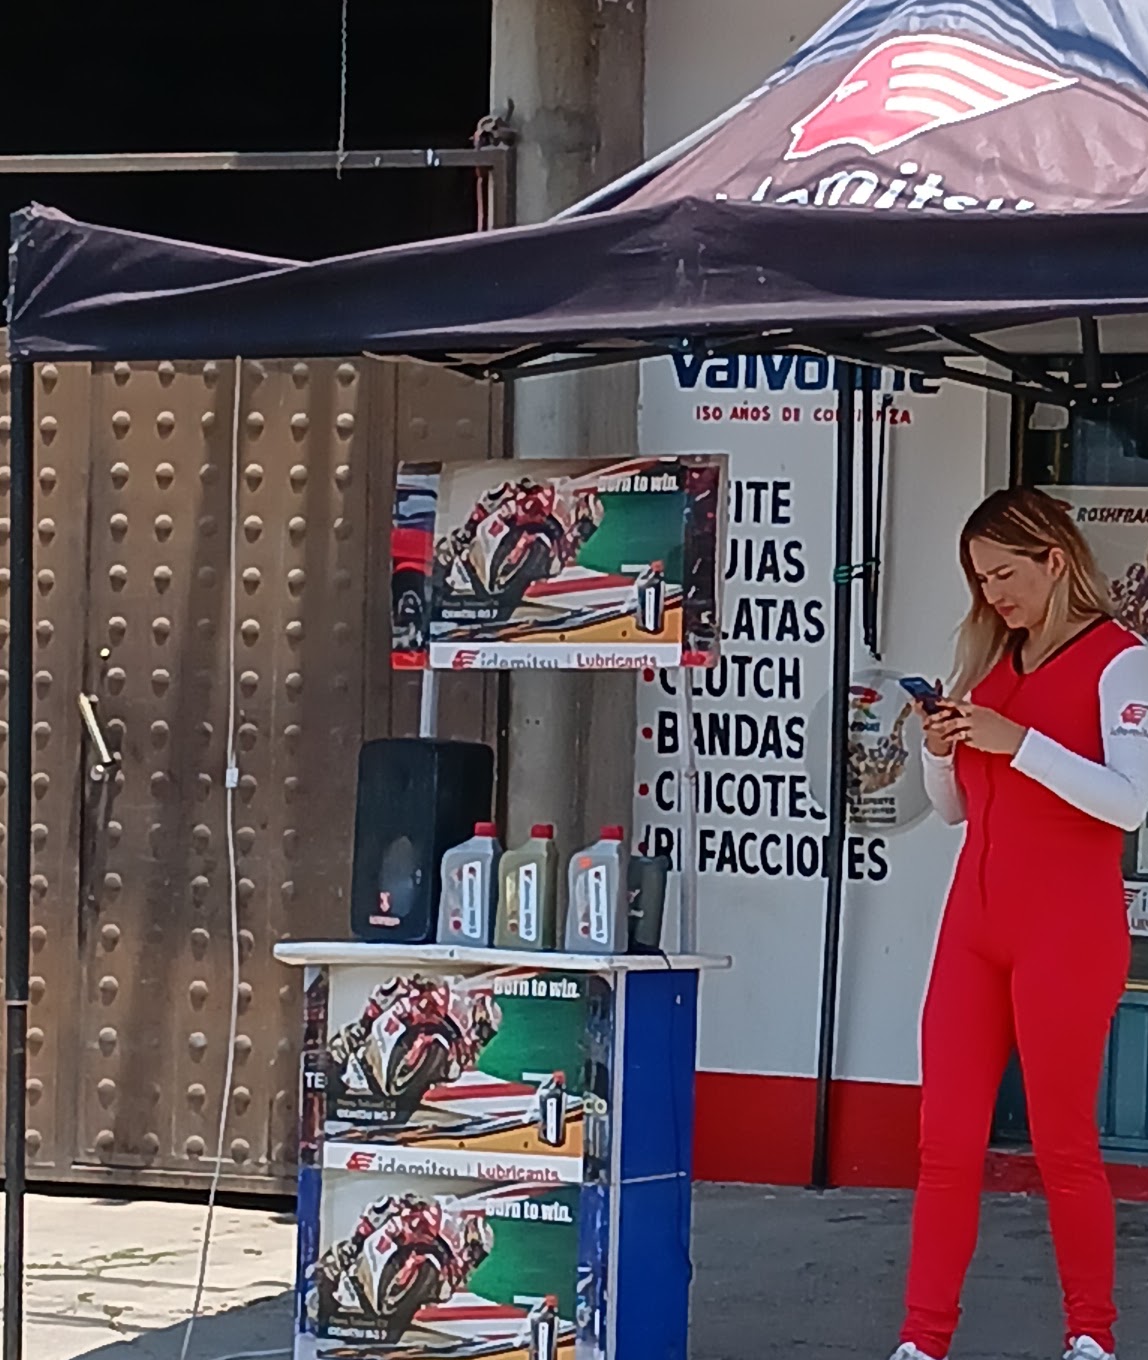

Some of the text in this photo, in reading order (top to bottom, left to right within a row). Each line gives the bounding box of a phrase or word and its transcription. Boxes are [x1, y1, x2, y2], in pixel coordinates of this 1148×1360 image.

[695, 406, 723, 420] 150
[729, 400, 771, 421] AÑOS
[722, 597, 825, 643] ATAS
[531, 978, 547, 997] to
[523, 1201, 539, 1220] to
